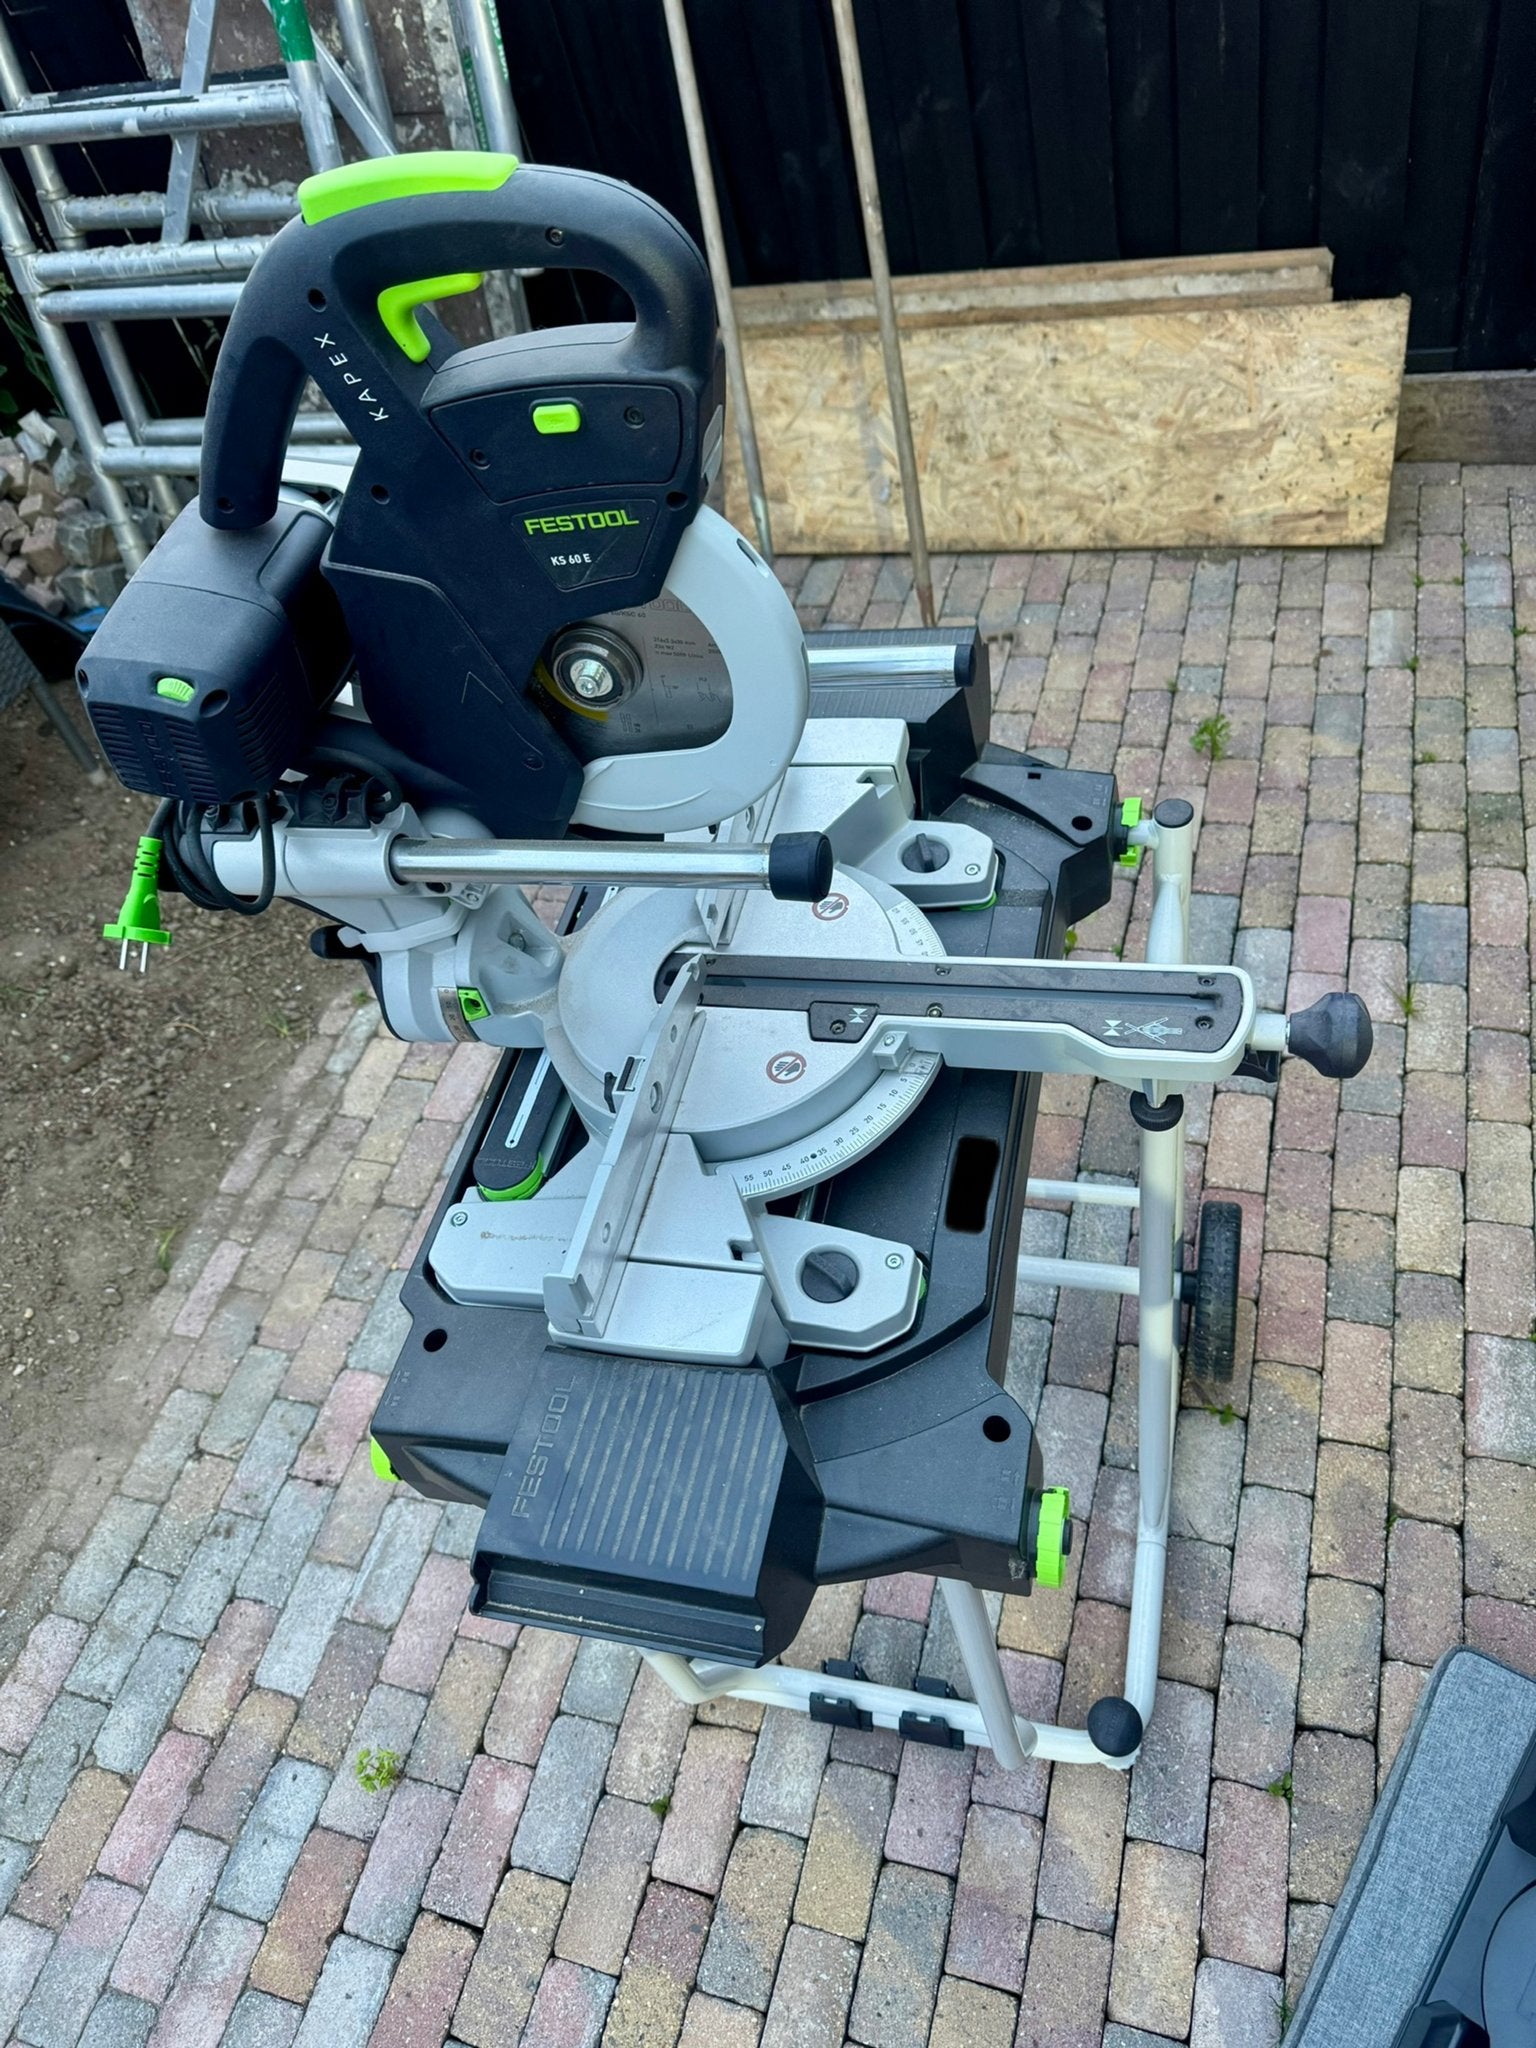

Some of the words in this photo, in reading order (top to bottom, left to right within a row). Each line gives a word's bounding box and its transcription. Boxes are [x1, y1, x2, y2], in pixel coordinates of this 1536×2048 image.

[313, 333, 389, 421] KAPEX
[524, 509, 639, 535] FESTOOL
[550, 555, 567, 567] KS
[568, 554, 582, 565] 60
[582, 553, 592, 563] E
[743, 1174, 755, 1182] 55
[762, 1169, 773, 1178] 50
[781, 1163, 792, 1172] 45
[800, 1156, 810, 1164] 40
[816, 1147, 828, 1156] 35
[833, 1136, 844, 1146] 30
[849, 1126, 860, 1136] 25
[863, 1114, 874, 1124] 20
[876, 1103, 887, 1111] 15
[888, 1089, 898, 1098] 10
[511, 1376, 576, 1519] FESTOOL
